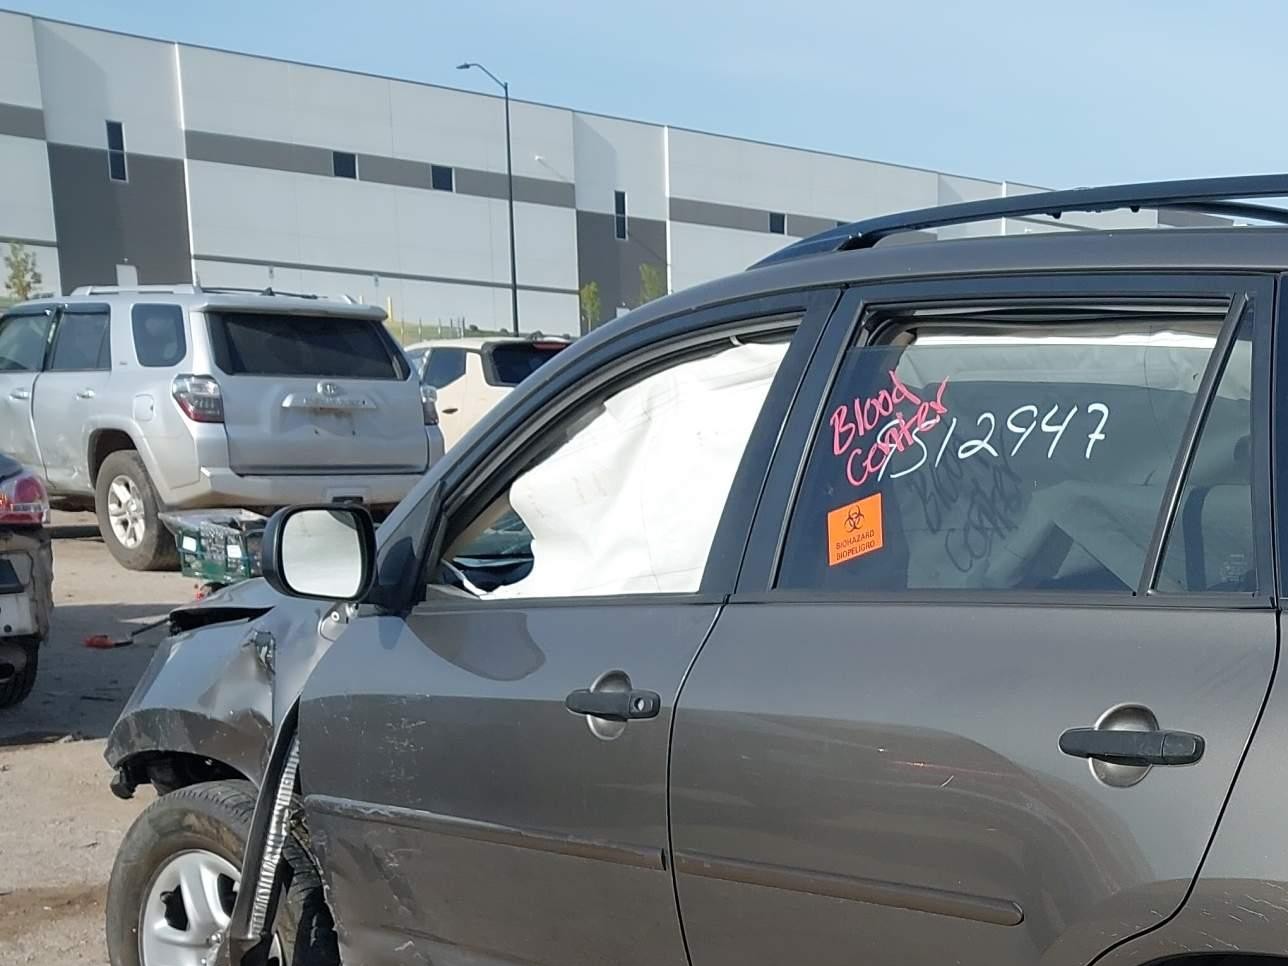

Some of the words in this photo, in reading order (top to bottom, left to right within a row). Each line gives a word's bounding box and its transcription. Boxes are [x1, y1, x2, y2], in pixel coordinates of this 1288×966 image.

[830, 369, 921, 455] Blood
[835, 529, 875, 550] BIOHAZARD
[836, 539, 876, 561] BIOPELIGRO
